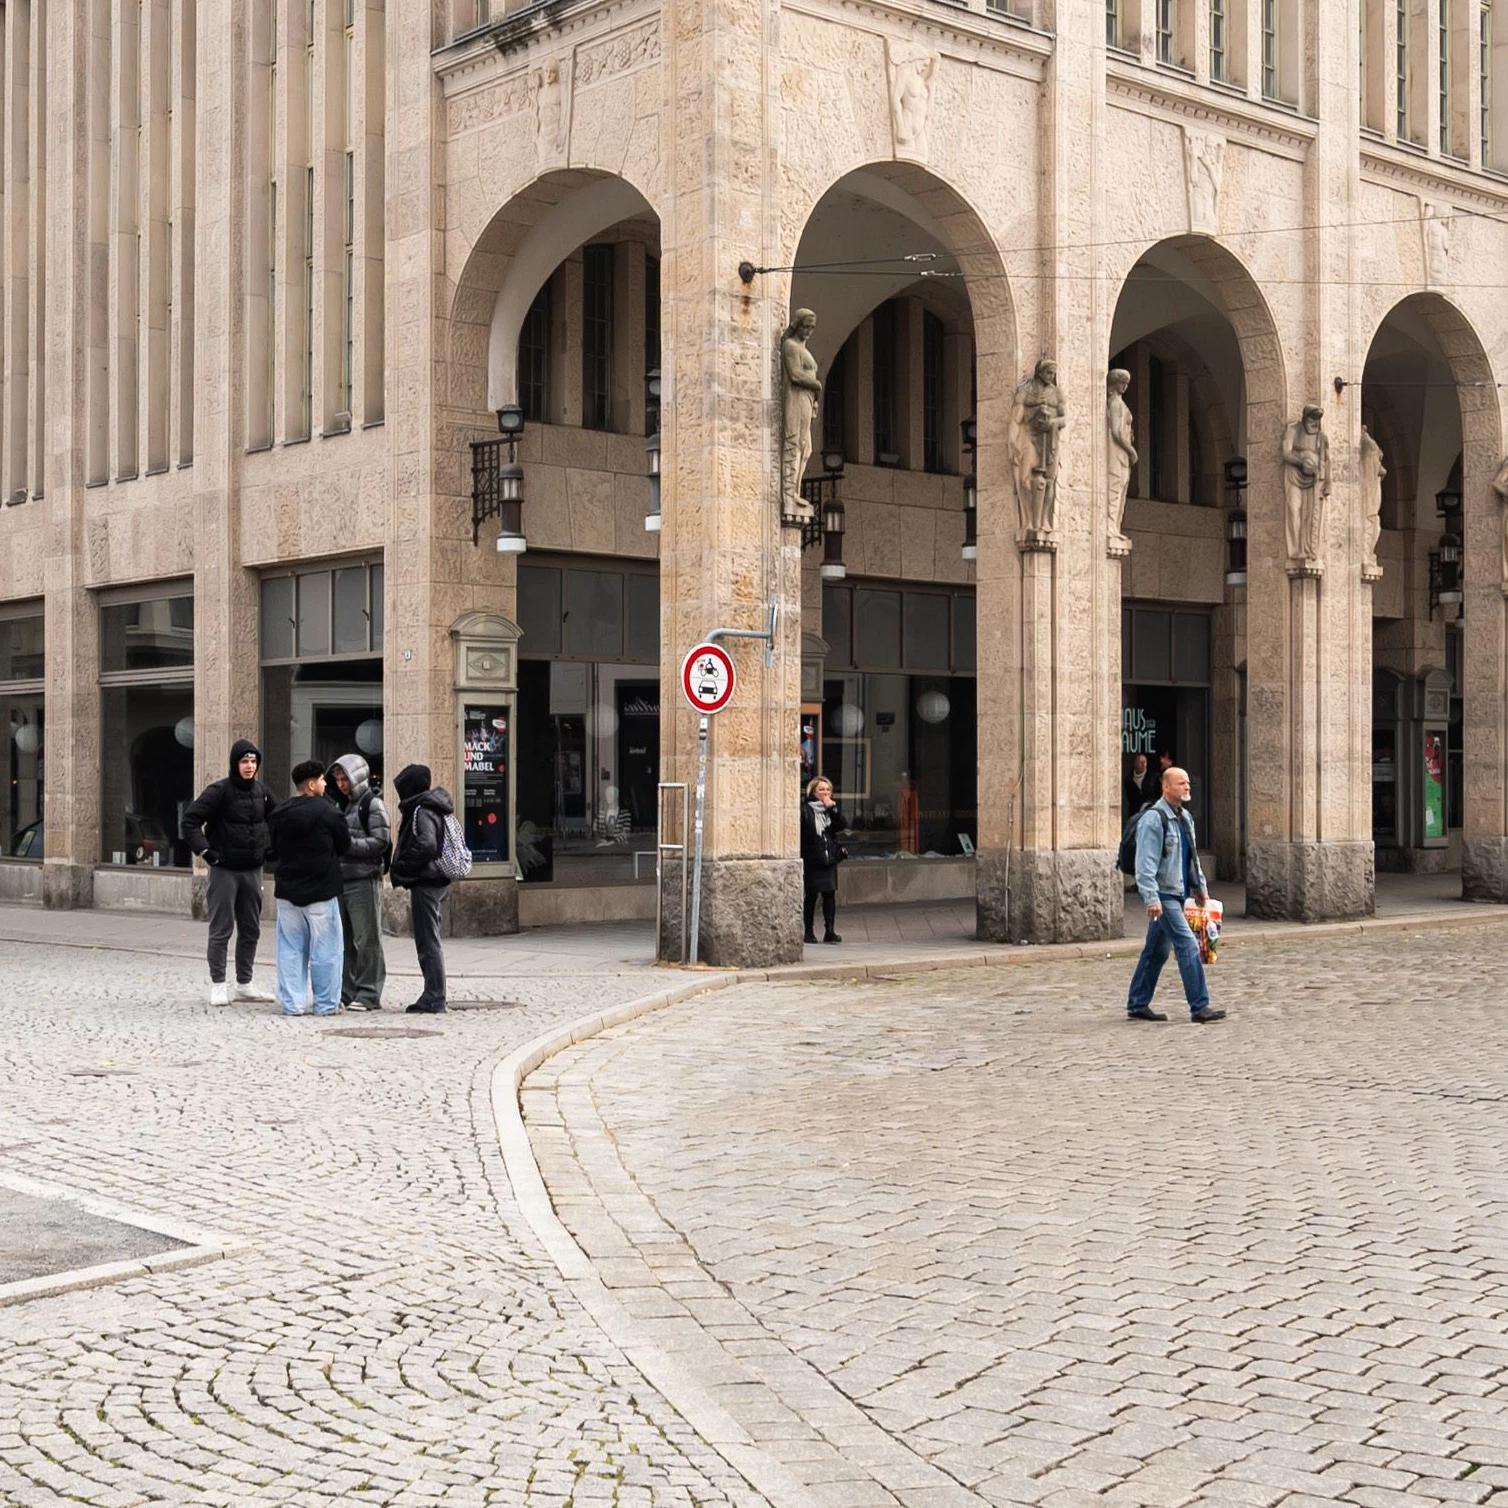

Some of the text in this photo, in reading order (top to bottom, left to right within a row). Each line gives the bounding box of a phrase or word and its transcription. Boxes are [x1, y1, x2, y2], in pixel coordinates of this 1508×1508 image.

[1121, 707, 1146, 731] AUS
[464, 741, 490, 751] MACK
[464, 752, 484, 761] UND
[464, 762, 495, 771] MABEL
